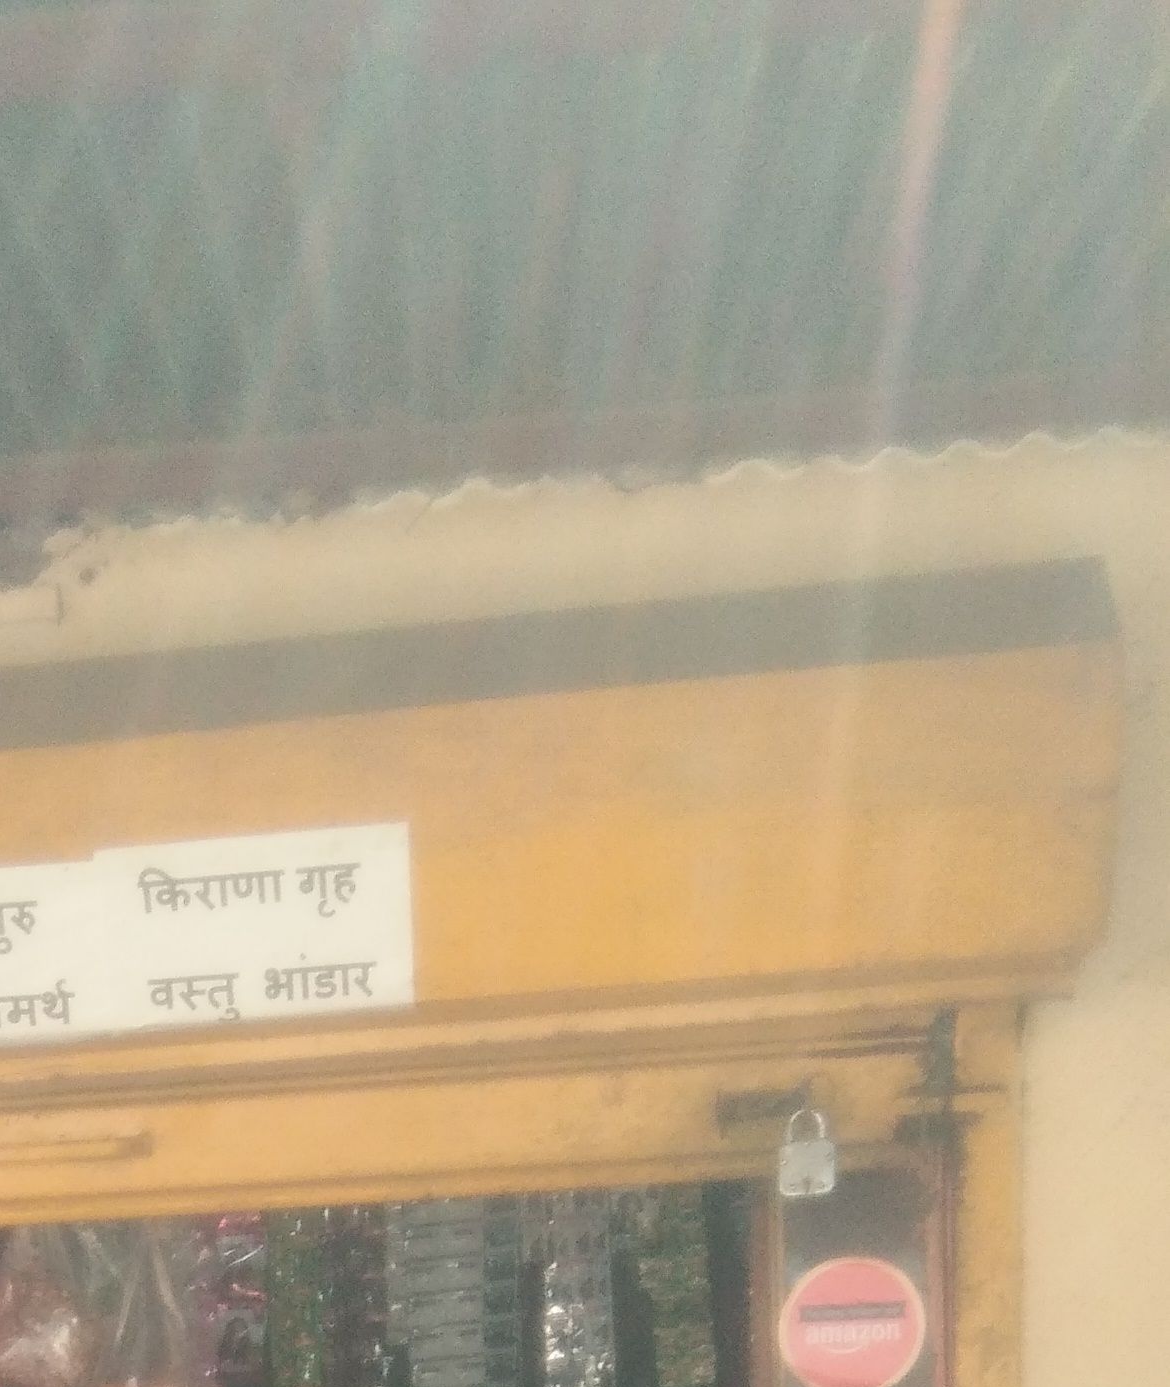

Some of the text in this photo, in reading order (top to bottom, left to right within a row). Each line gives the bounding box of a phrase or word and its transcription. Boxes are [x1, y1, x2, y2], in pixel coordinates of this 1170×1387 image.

[137, 862, 361, 918] किराणा गृह
[146, 952, 378, 1021] वस्तु भांडार
